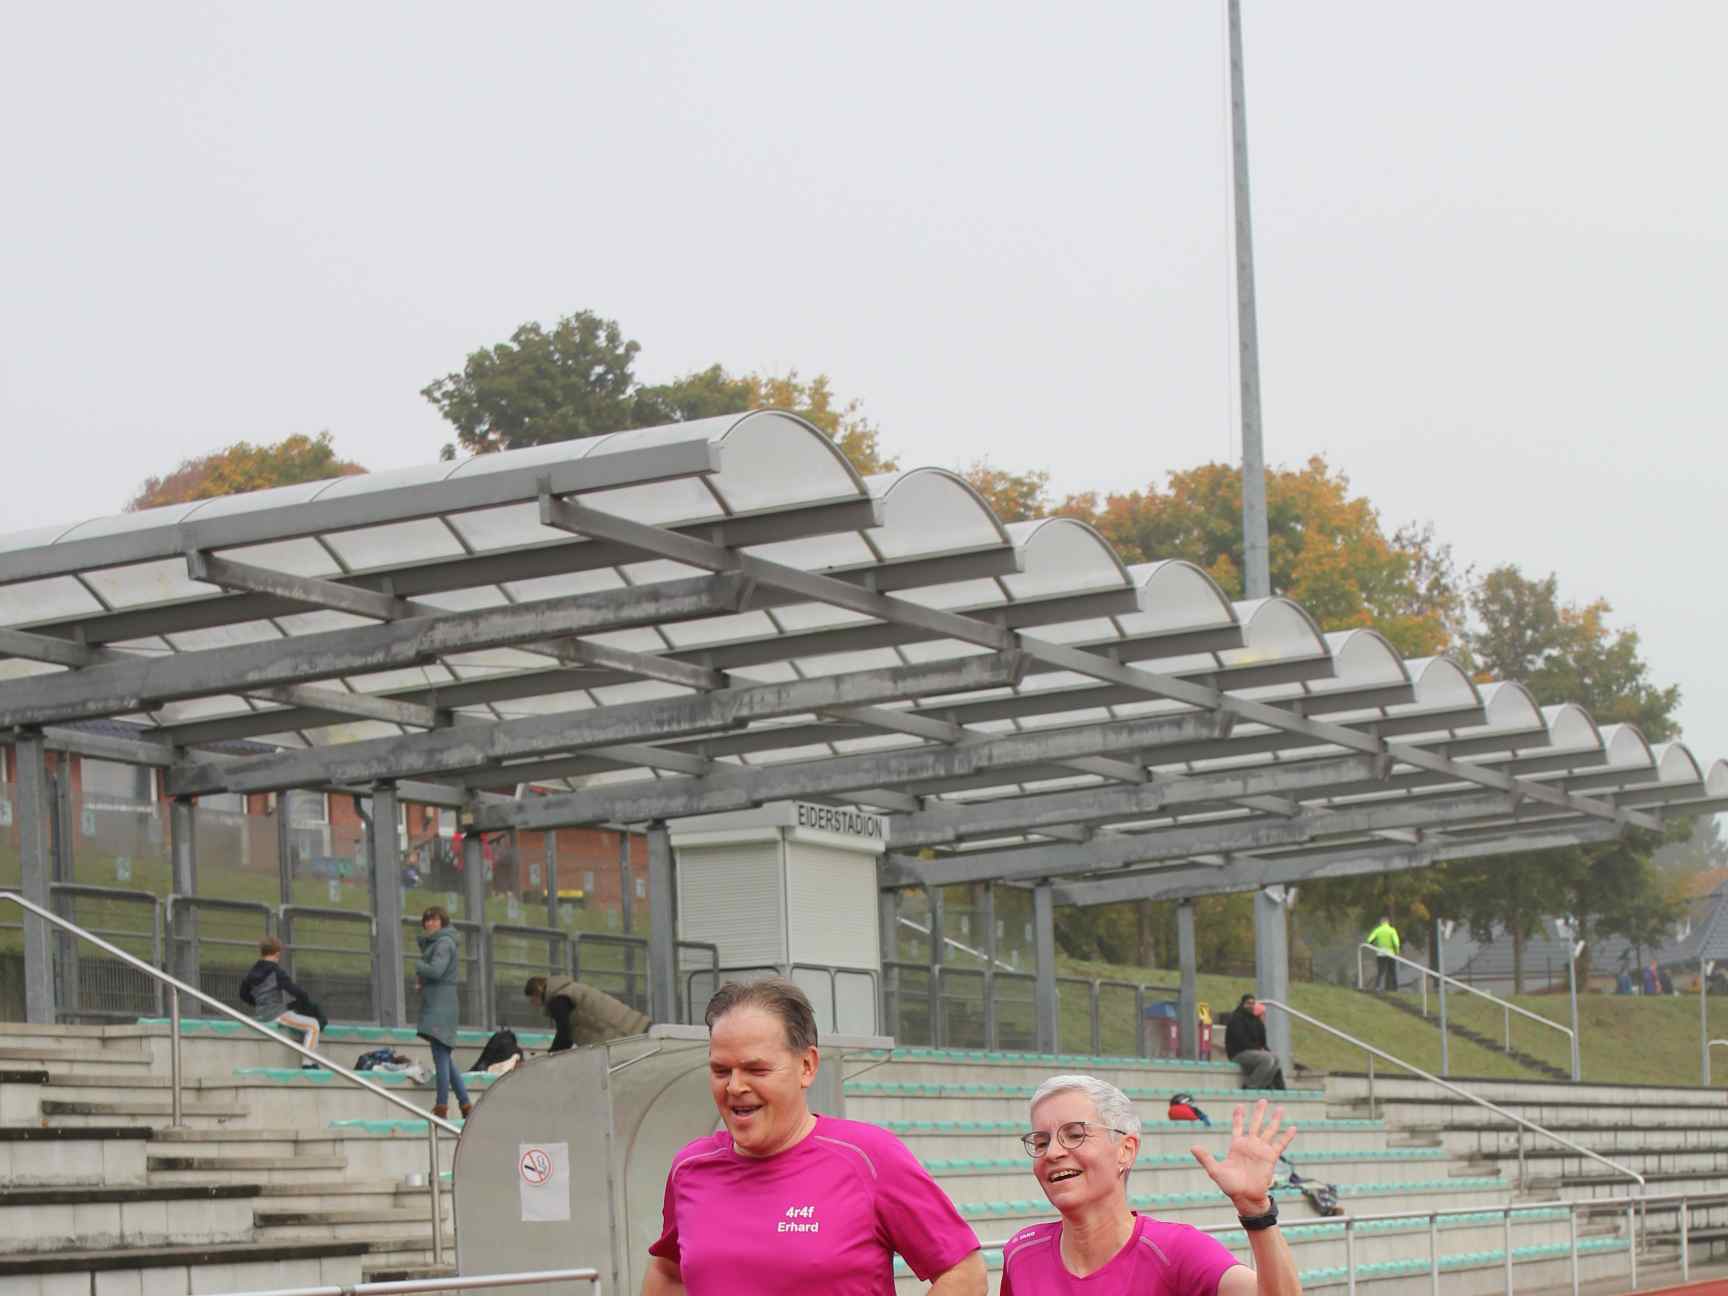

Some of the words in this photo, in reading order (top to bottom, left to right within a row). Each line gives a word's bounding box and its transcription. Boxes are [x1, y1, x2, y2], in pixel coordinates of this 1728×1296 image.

[798, 804, 883, 838] EIDERSTADION
[785, 1206, 815, 1218] 4r4f
[777, 1222, 819, 1232] Erhard
